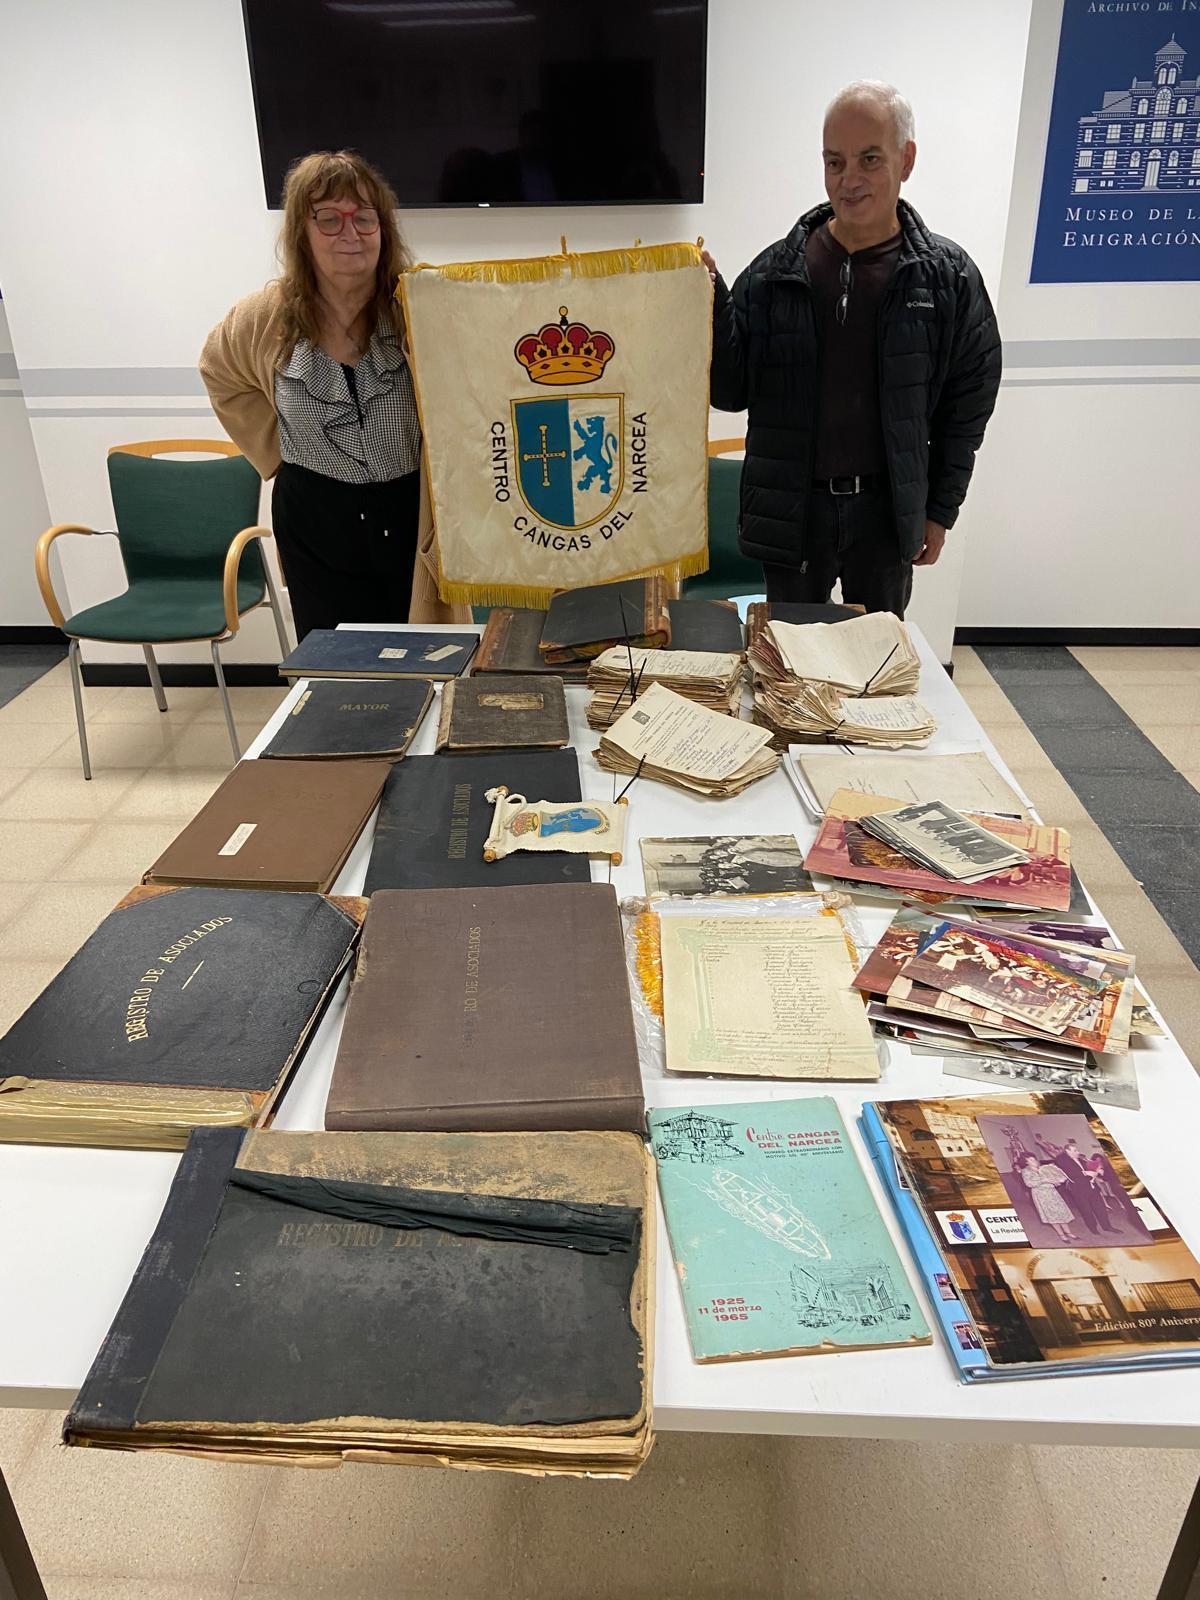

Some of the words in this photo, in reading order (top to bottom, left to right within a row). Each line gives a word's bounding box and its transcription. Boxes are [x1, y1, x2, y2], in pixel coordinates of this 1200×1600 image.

[1087, 1, 1150, 13] ARCHIVO
[1158, 1, 1173, 11] DE
[1065, 207, 1134, 222] MUSEO
[1148, 208, 1174, 221] DE
[1187, 208, 1200, 220] L
[1063, 229, 1200, 247] EMIGRACIÓN
[490, 421, 510, 503] CENTRO
[513, 516, 592, 552] CANGAS
[599, 510, 633, 540] DEL
[632, 412, 648, 493] NARCEA
[339, 703, 391, 711] MAYOR
[466, 926, 481, 978] ASOCIADOS
[125, 987, 153, 1043] REGISTRO
[140, 968, 165, 983] DE
[158, 916, 233, 964] ASOCIADOS
[465, 980, 479, 994] DE
[787, 1130, 840, 1139] CANGAS
[758, 1141, 783, 1149] DEL
[788, 1137, 843, 1147] NARCEA
[985, 1216, 1021, 1224] CENTR
[711, 1297, 745, 1306] 1925
[714, 1313, 749, 1322] 1965
[1094, 1319, 1137, 1332] Edición
